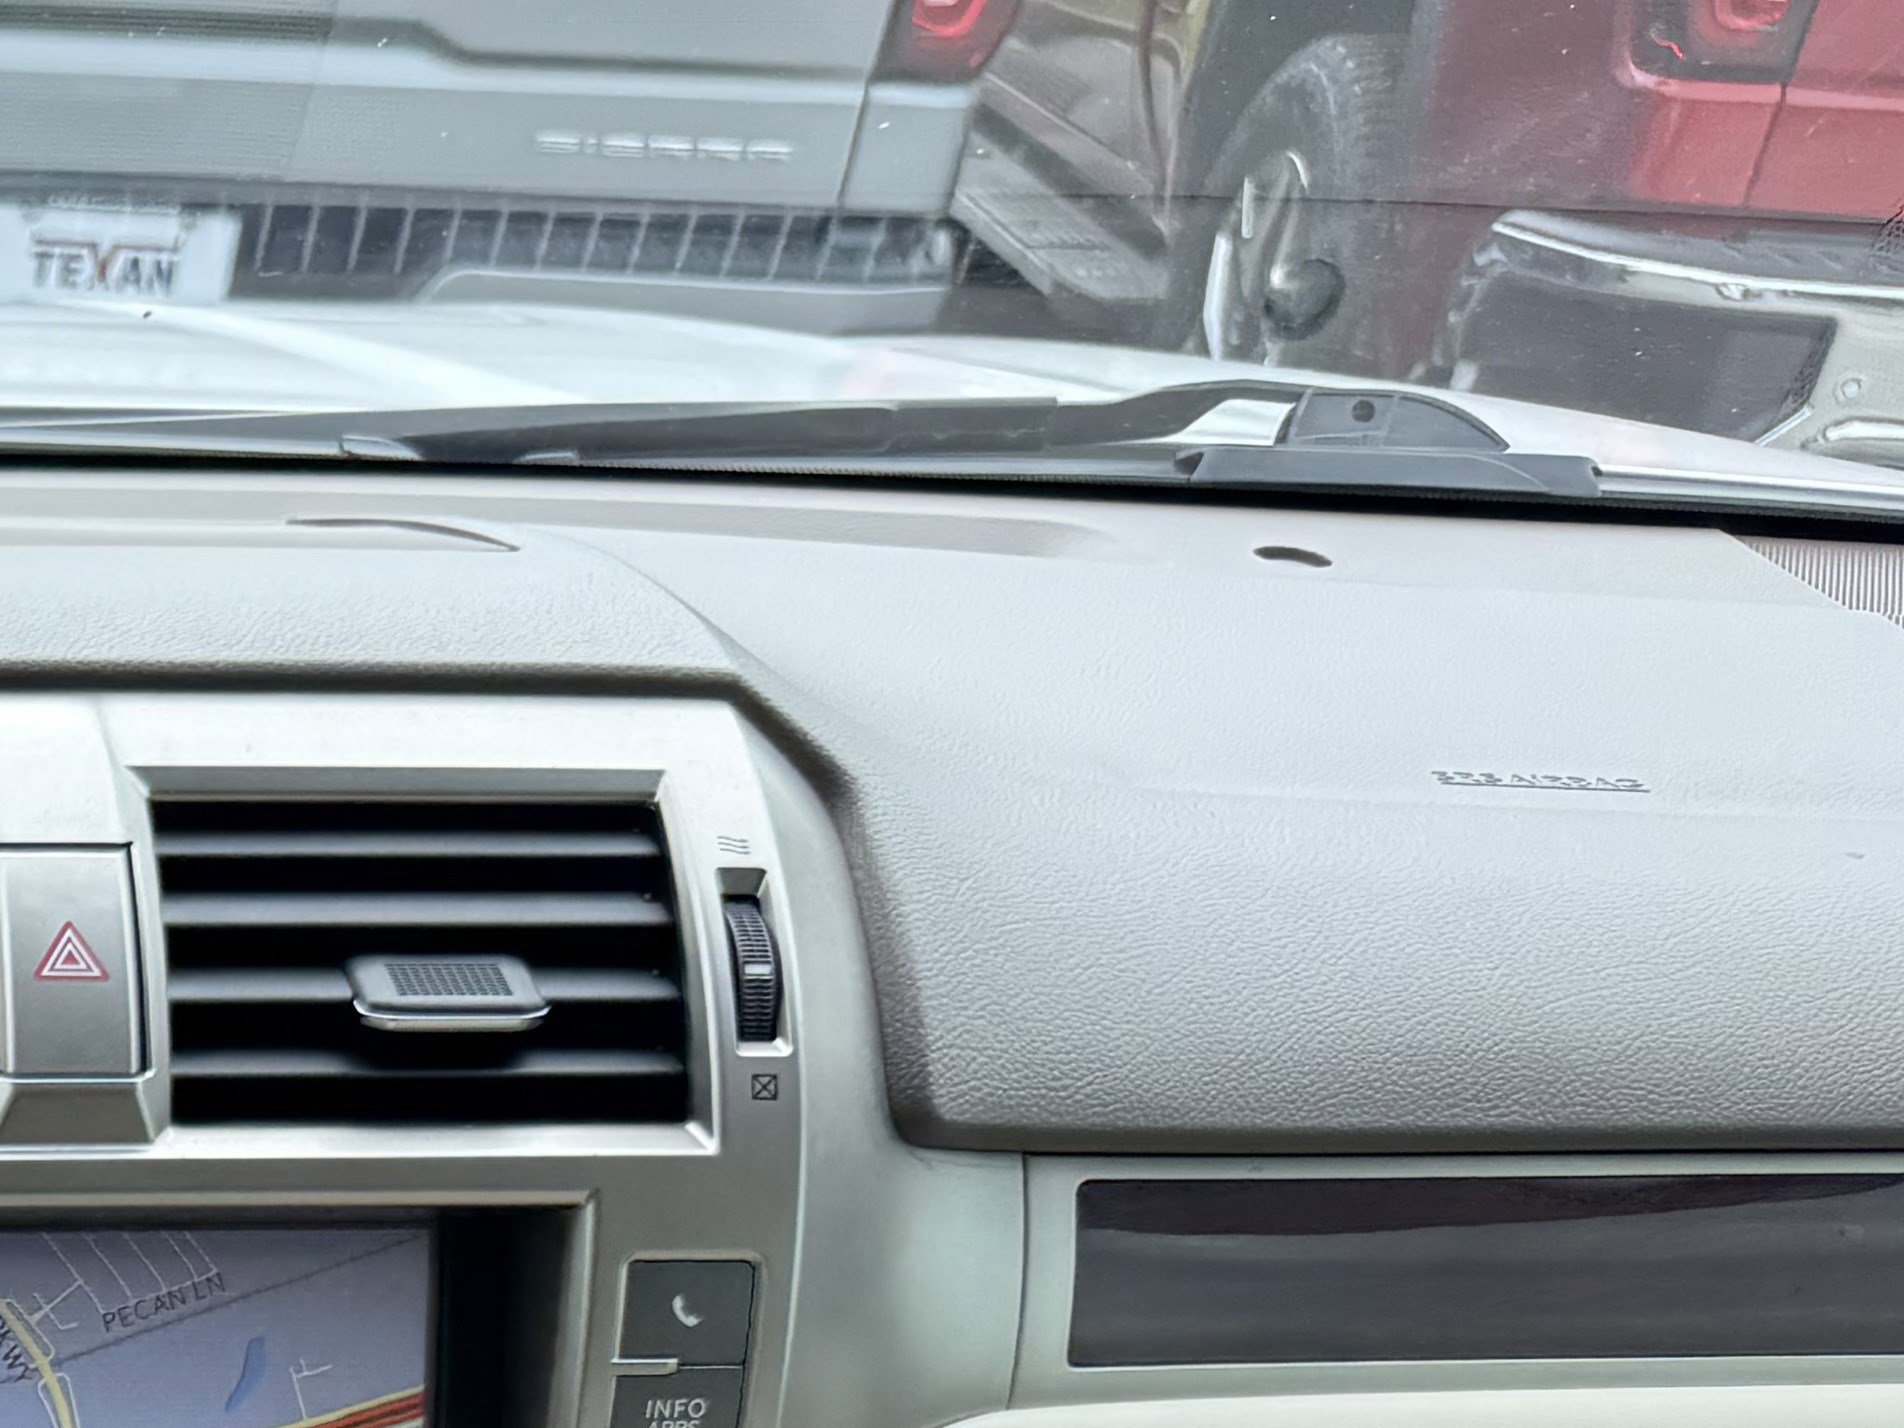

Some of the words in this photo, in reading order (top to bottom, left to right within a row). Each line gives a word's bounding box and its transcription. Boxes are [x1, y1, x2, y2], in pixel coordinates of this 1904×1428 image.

[30, 238, 176, 293] TEXAN
[102, 1287, 187, 1333] PECAN
[195, 1272, 226, 1301] LN
[645, 1398, 707, 1419] INFO
